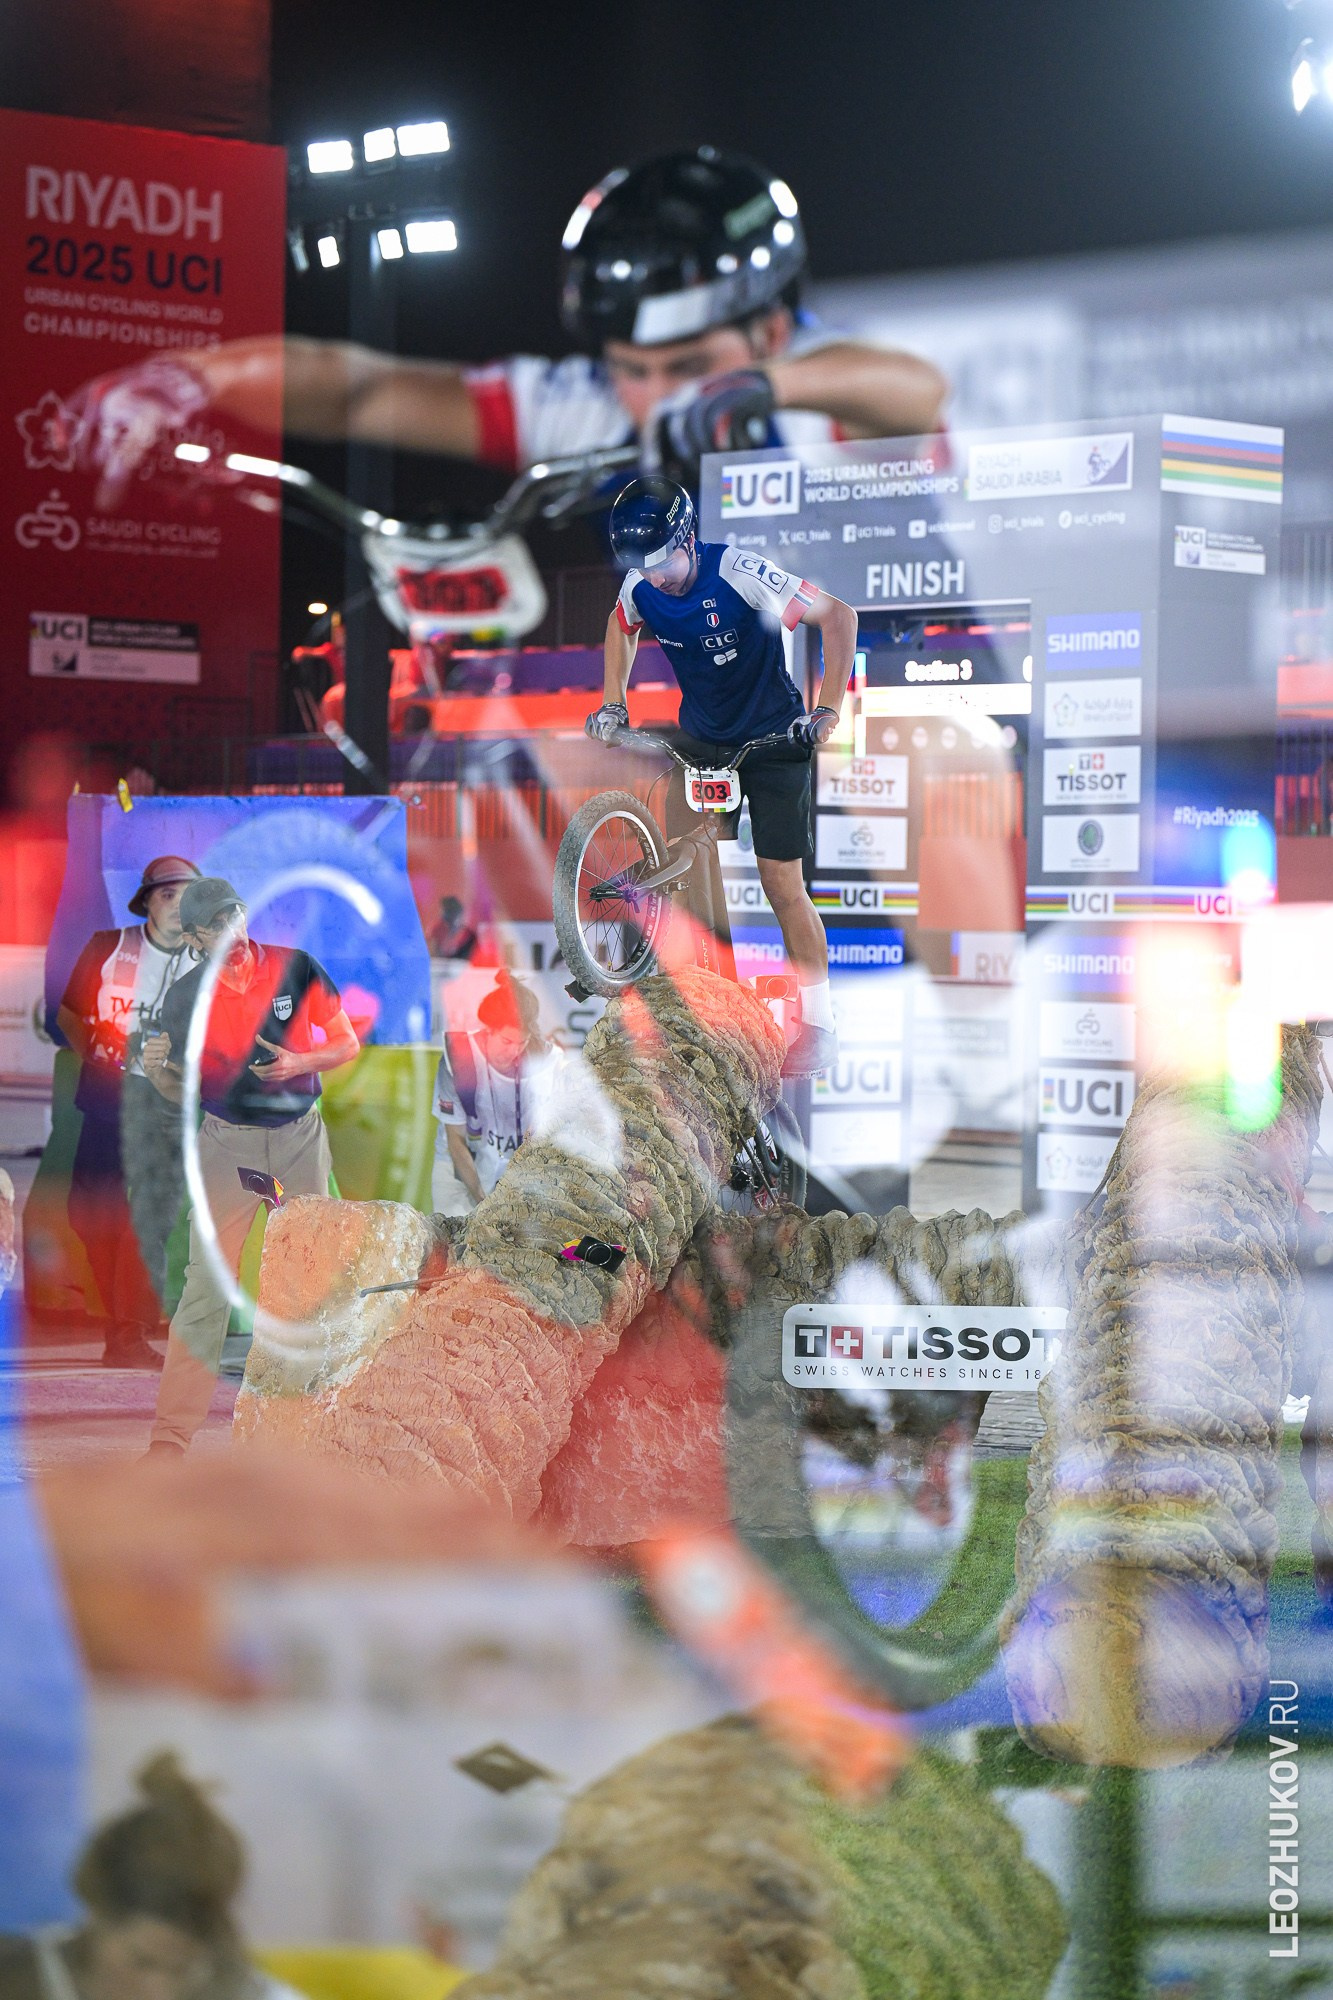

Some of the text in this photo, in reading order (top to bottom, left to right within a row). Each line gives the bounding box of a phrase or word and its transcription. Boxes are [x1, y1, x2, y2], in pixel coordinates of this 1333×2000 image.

[25, 164, 223, 243] RIYADH
[27, 234, 223, 296] 2025 UCI
[24, 311, 222, 353] CHAMPIONSHIPS
[879, 458, 935, 478] CYCLING
[736, 470, 792, 507] UCI
[804, 477, 960, 504] WORLD CHAMPIONSHIPS
[1181, 530, 1203, 545] UCI
[741, 559, 783, 586] CIC
[866, 560, 966, 599] FINISH
[40, 619, 83, 640] UCI
[705, 632, 735, 648] CIC
[1047, 629, 1141, 654] SHIMANO
[694, 784, 728, 801] 303
[830, 777, 896, 795] TISSOT
[1057, 772, 1127, 792] TISSOT
[1173, 806, 1260, 830] #Riyadh2025
[729, 886, 761, 905] UCI
[842, 888, 878, 908] UCI
[1070, 893, 1108, 914] UCI
[1197, 895, 1232, 916] UCI
[733, 943, 785, 962] MANO
[828, 944, 904, 964] HIMANO
[974, 953, 1015, 980] RIY
[1043, 953, 1136, 975] SHIMANO
[830, 1060, 891, 1093] UCI
[1058, 1079, 1123, 1117] UCI
[871, 1325, 1068, 1362] TISSOT
[793, 1365, 1041, 1380] SWISS WATCHES SINCE 18
